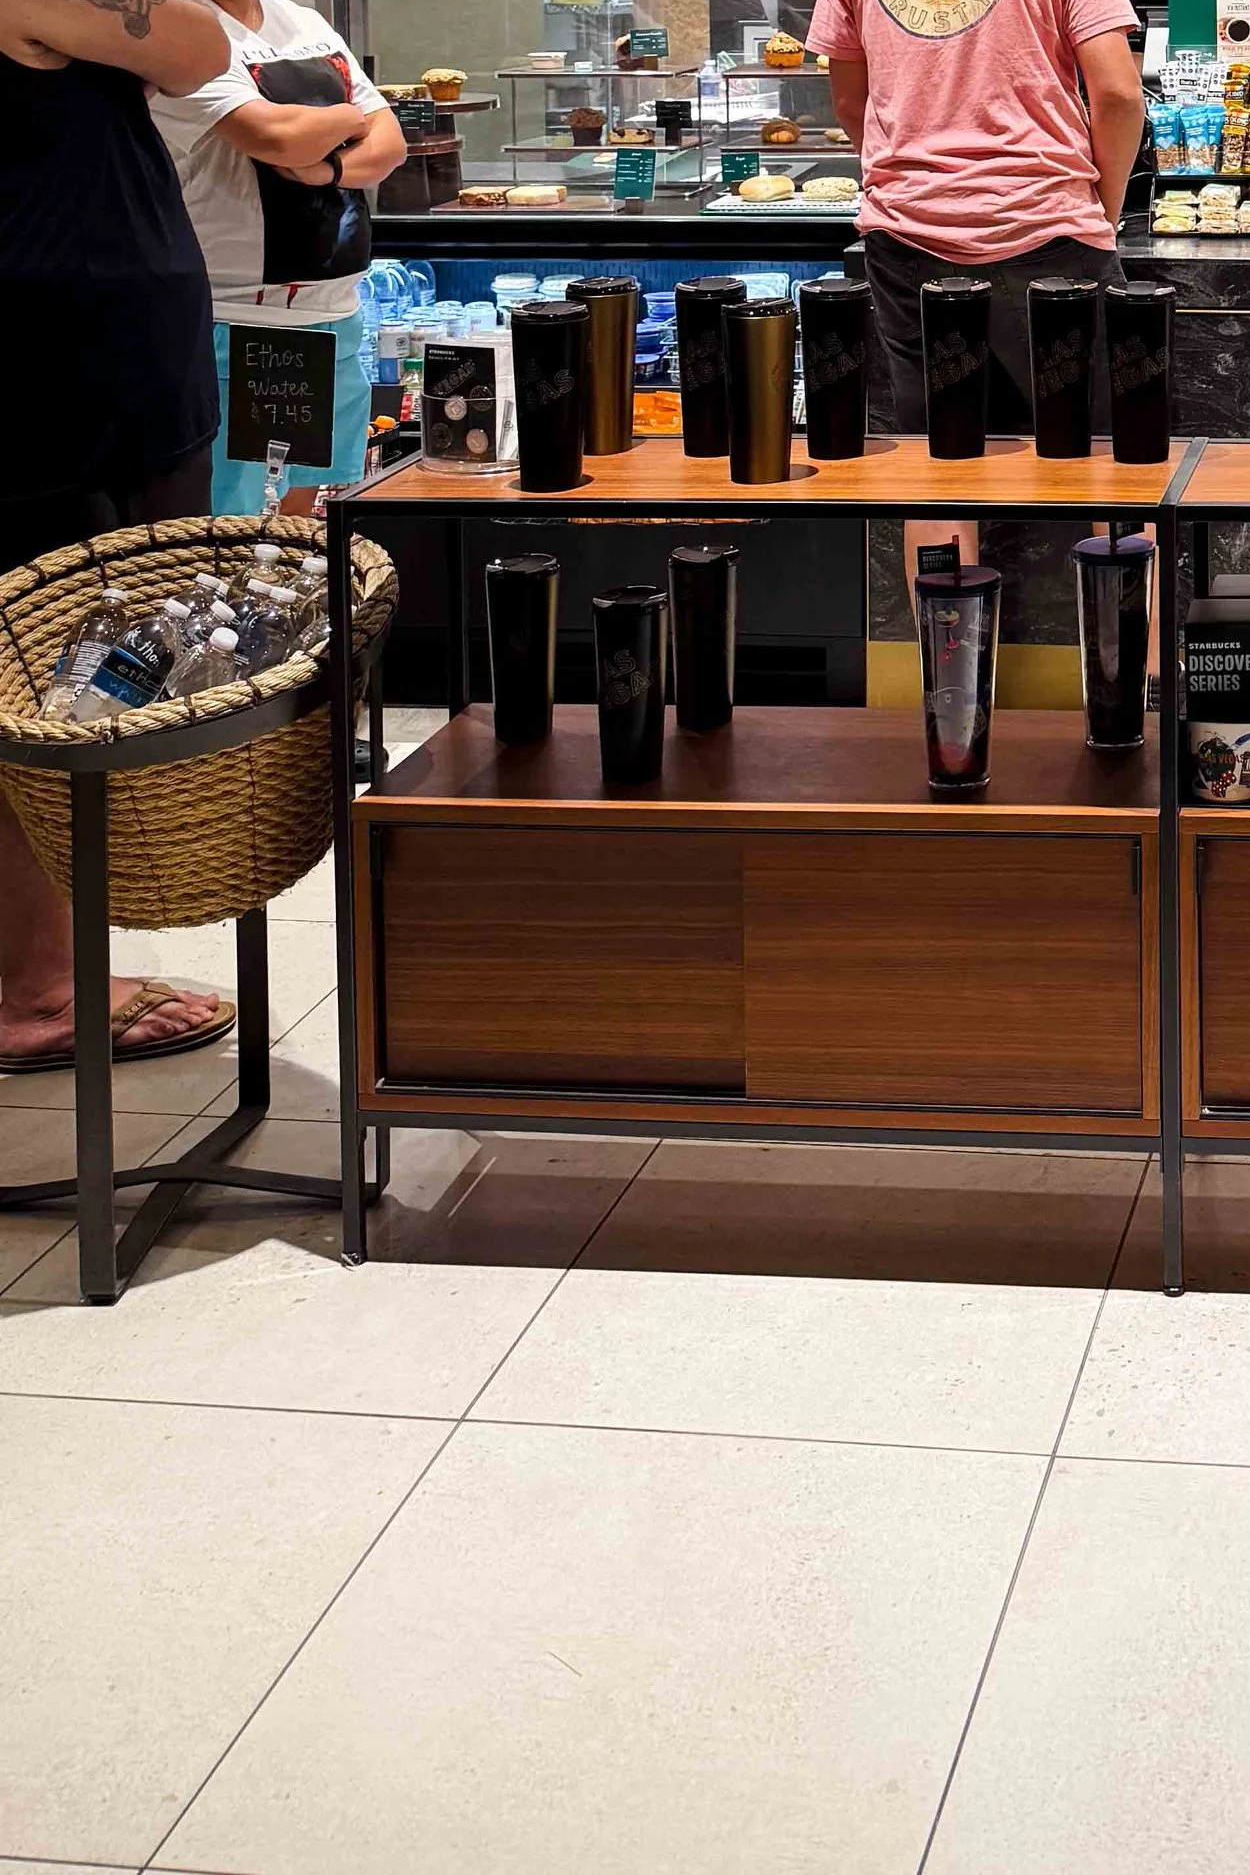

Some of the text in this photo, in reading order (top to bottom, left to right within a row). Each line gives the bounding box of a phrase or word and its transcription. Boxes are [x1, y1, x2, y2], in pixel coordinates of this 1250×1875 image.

[246, 342, 305, 368] Ethos
[248, 378, 314, 398] Water
[1188, 641, 1242, 651] STARBUCKS
[1189, 675, 1241, 692] SERIES
